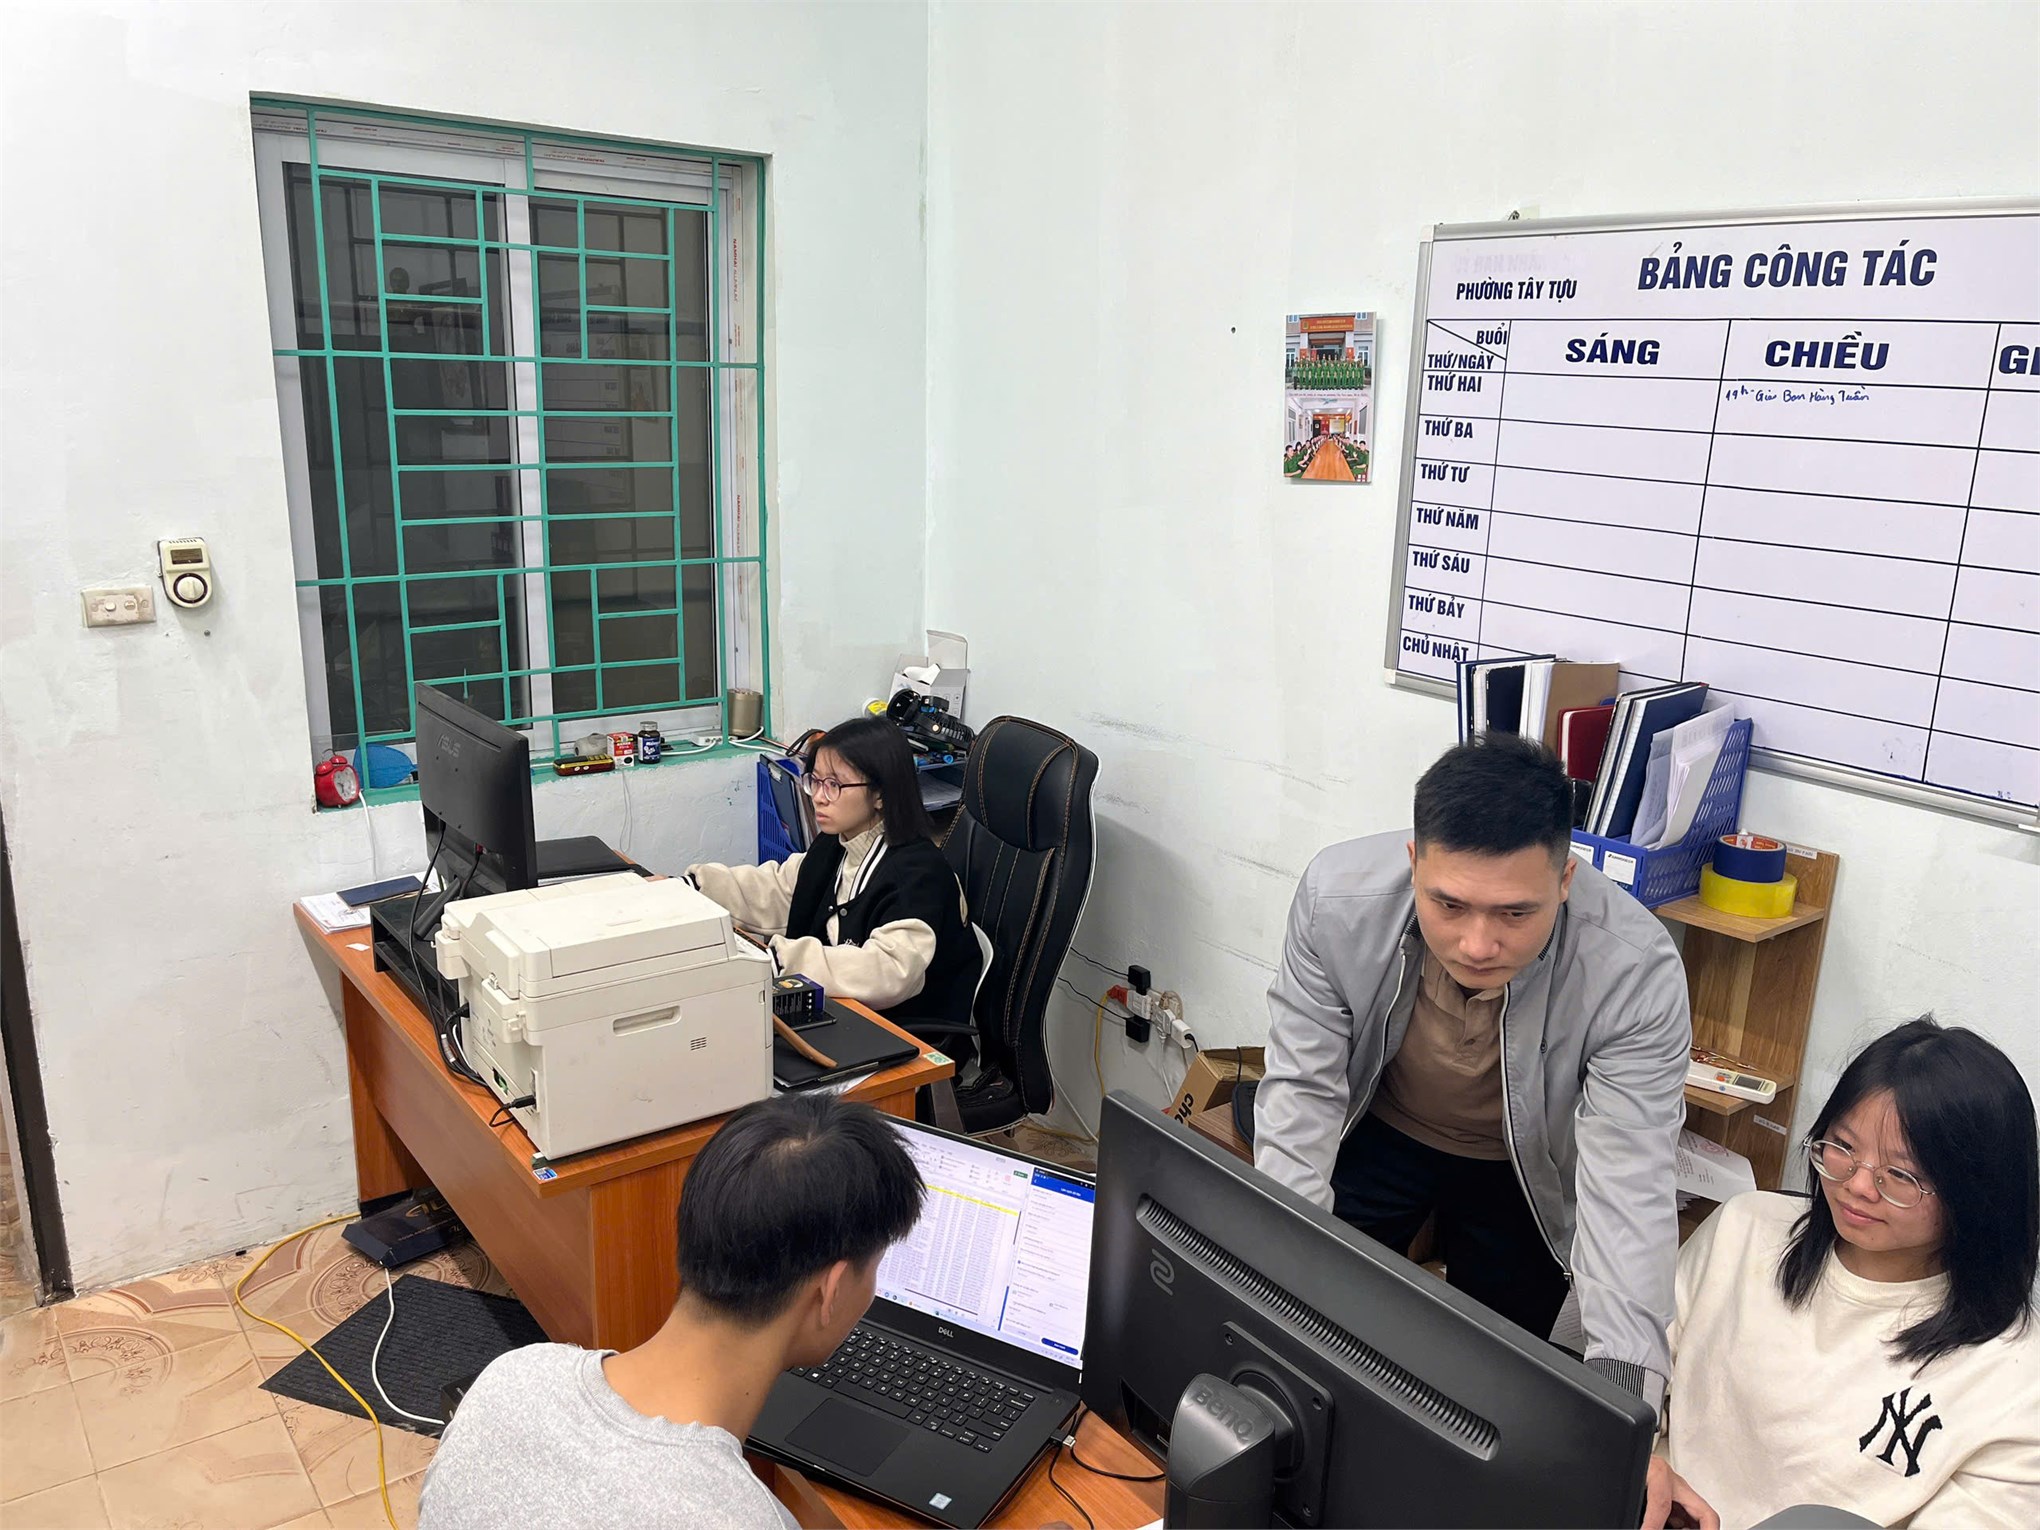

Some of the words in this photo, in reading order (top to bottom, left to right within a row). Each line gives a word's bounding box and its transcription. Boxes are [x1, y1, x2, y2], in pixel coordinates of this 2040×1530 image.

[1637, 241, 1733, 290] BẢNG
[1743, 243, 1849, 288] CÔNG
[1862, 239, 1938, 286] TÁC
[1456, 276, 1514, 300] PHƯỜNG
[1517, 276, 1545, 300] TÂY
[1549, 278, 1577, 303] TỰU
[1476, 322, 1508, 345] BUỔI
[1427, 350, 1494, 370] THỨ/NGÀY
[1565, 332, 1661, 365] SÁNG
[1764, 331, 1890, 370] CHIỀU
[1427, 371, 1456, 391] THỨ
[1457, 376, 1482, 392] HAI
[1424, 417, 1453, 437] THỨ
[1454, 422, 1473, 438] BA
[1420, 461, 1449, 481] THỨ
[1450, 466, 1470, 483] TƯ
[1416, 506, 1445, 525] THỨ
[1445, 509, 1479, 530] NĂM
[1412, 550, 1440, 569] THỨ
[1441, 553, 1470, 573] SÁU
[1408, 593, 1436, 613] THỨ
[1437, 596, 1465, 619] BẢY
[1402, 634, 1430, 655] CHỦ
[1432, 642, 1469, 663] NHẬT
[938, 1326, 954, 1338] DELL
[1194, 1385, 1255, 1443] BenQ
